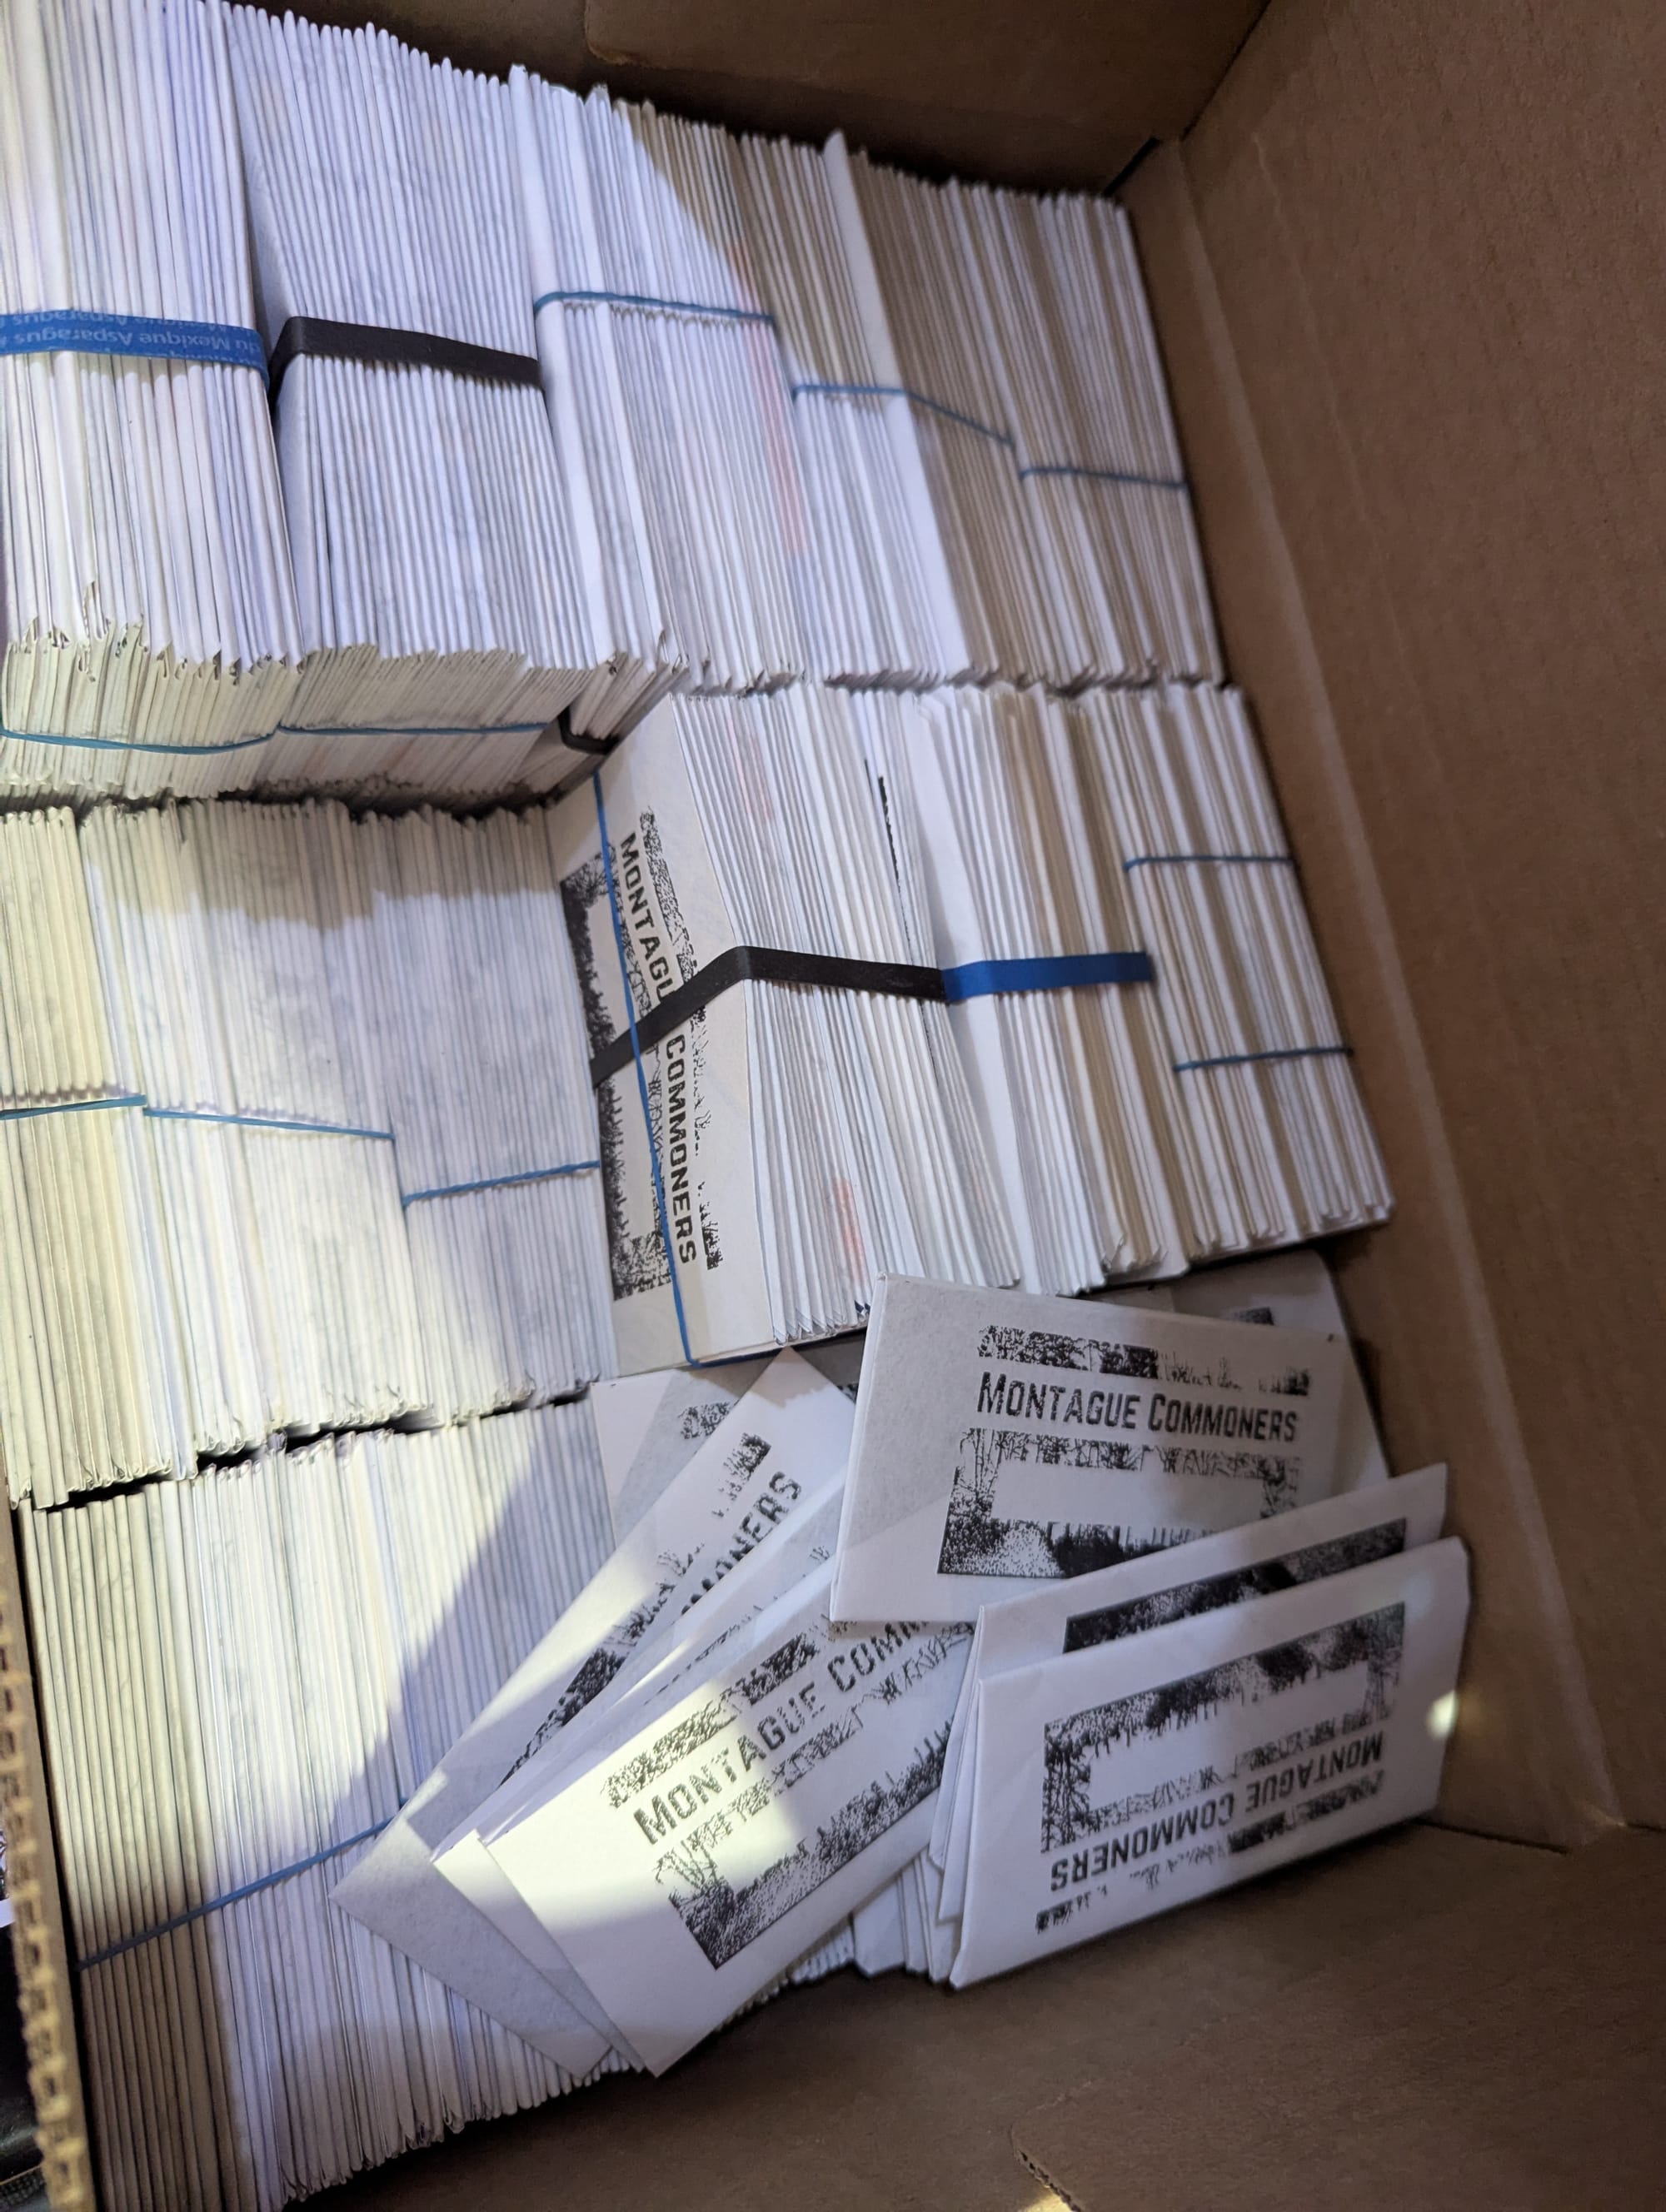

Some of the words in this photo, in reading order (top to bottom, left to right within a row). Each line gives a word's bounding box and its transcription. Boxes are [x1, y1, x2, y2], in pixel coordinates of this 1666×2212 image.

[13, 326, 132, 346] Asparagus
[138, 331, 231, 351] Mexique
[621, 832, 673, 1002] MONTAGU
[666, 1034, 696, 1263] COMMONERS
[977, 1371, 1141, 1430] MONTAGUE
[1148, 1392, 1299, 1442] COMMONERS
[633, 1681, 826, 1845] MONTAGUE
[1245, 1731, 1384, 1813] MONTAGUE
[1050, 1791, 1235, 1891] COMMONERS
